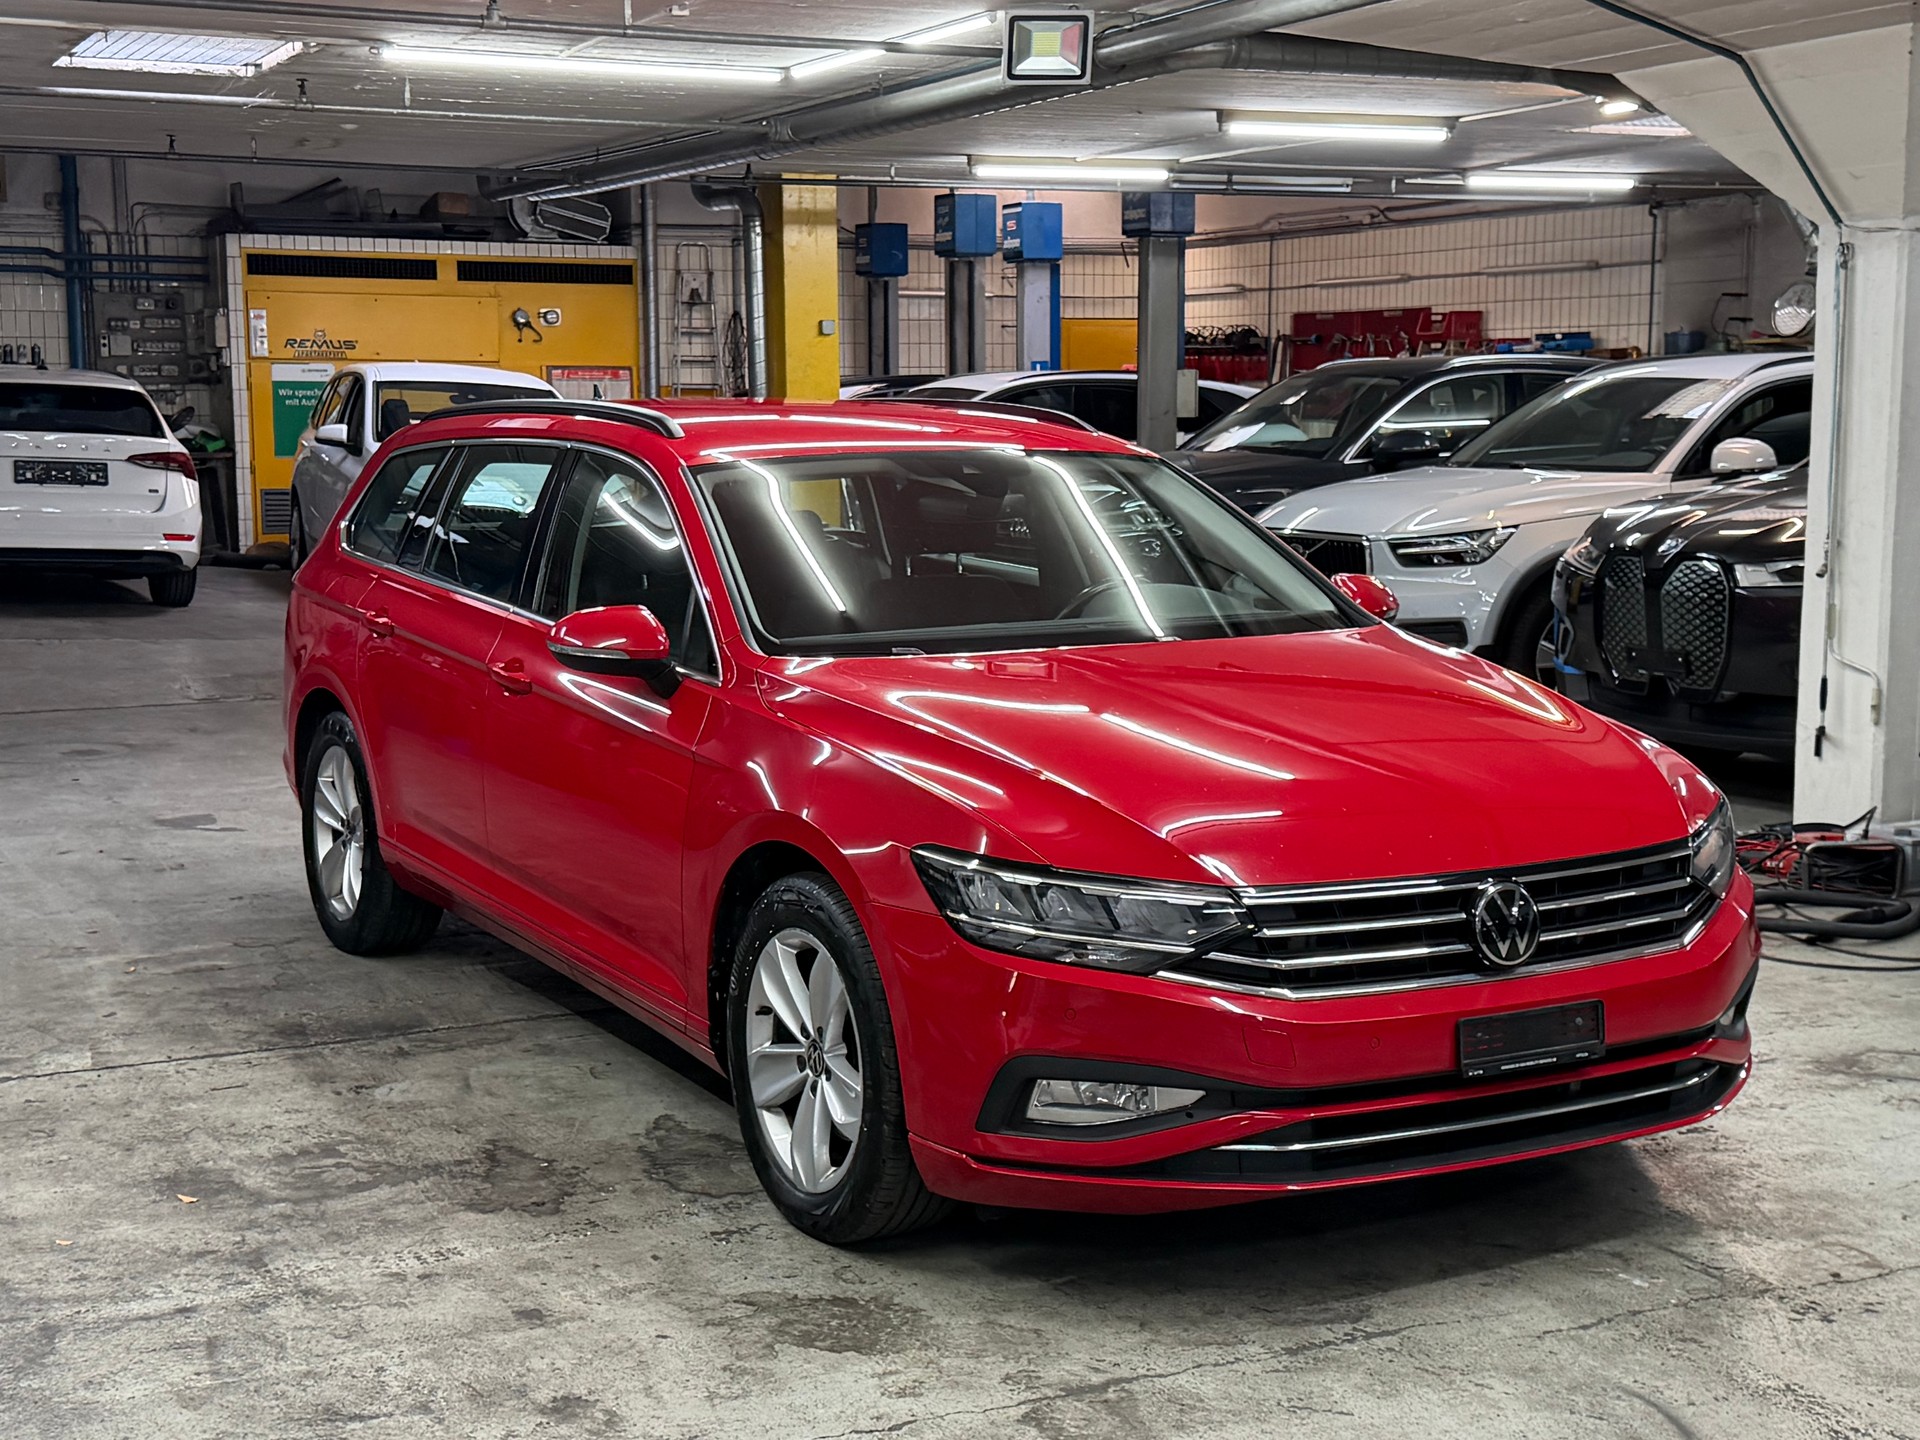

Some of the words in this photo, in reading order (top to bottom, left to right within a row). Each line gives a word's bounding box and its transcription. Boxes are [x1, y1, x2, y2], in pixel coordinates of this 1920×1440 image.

[284, 338, 357, 350] REMUS
[278, 388, 293, 397] Wir
[295, 388, 322, 398] sprech
[285, 398, 299, 406] mit
